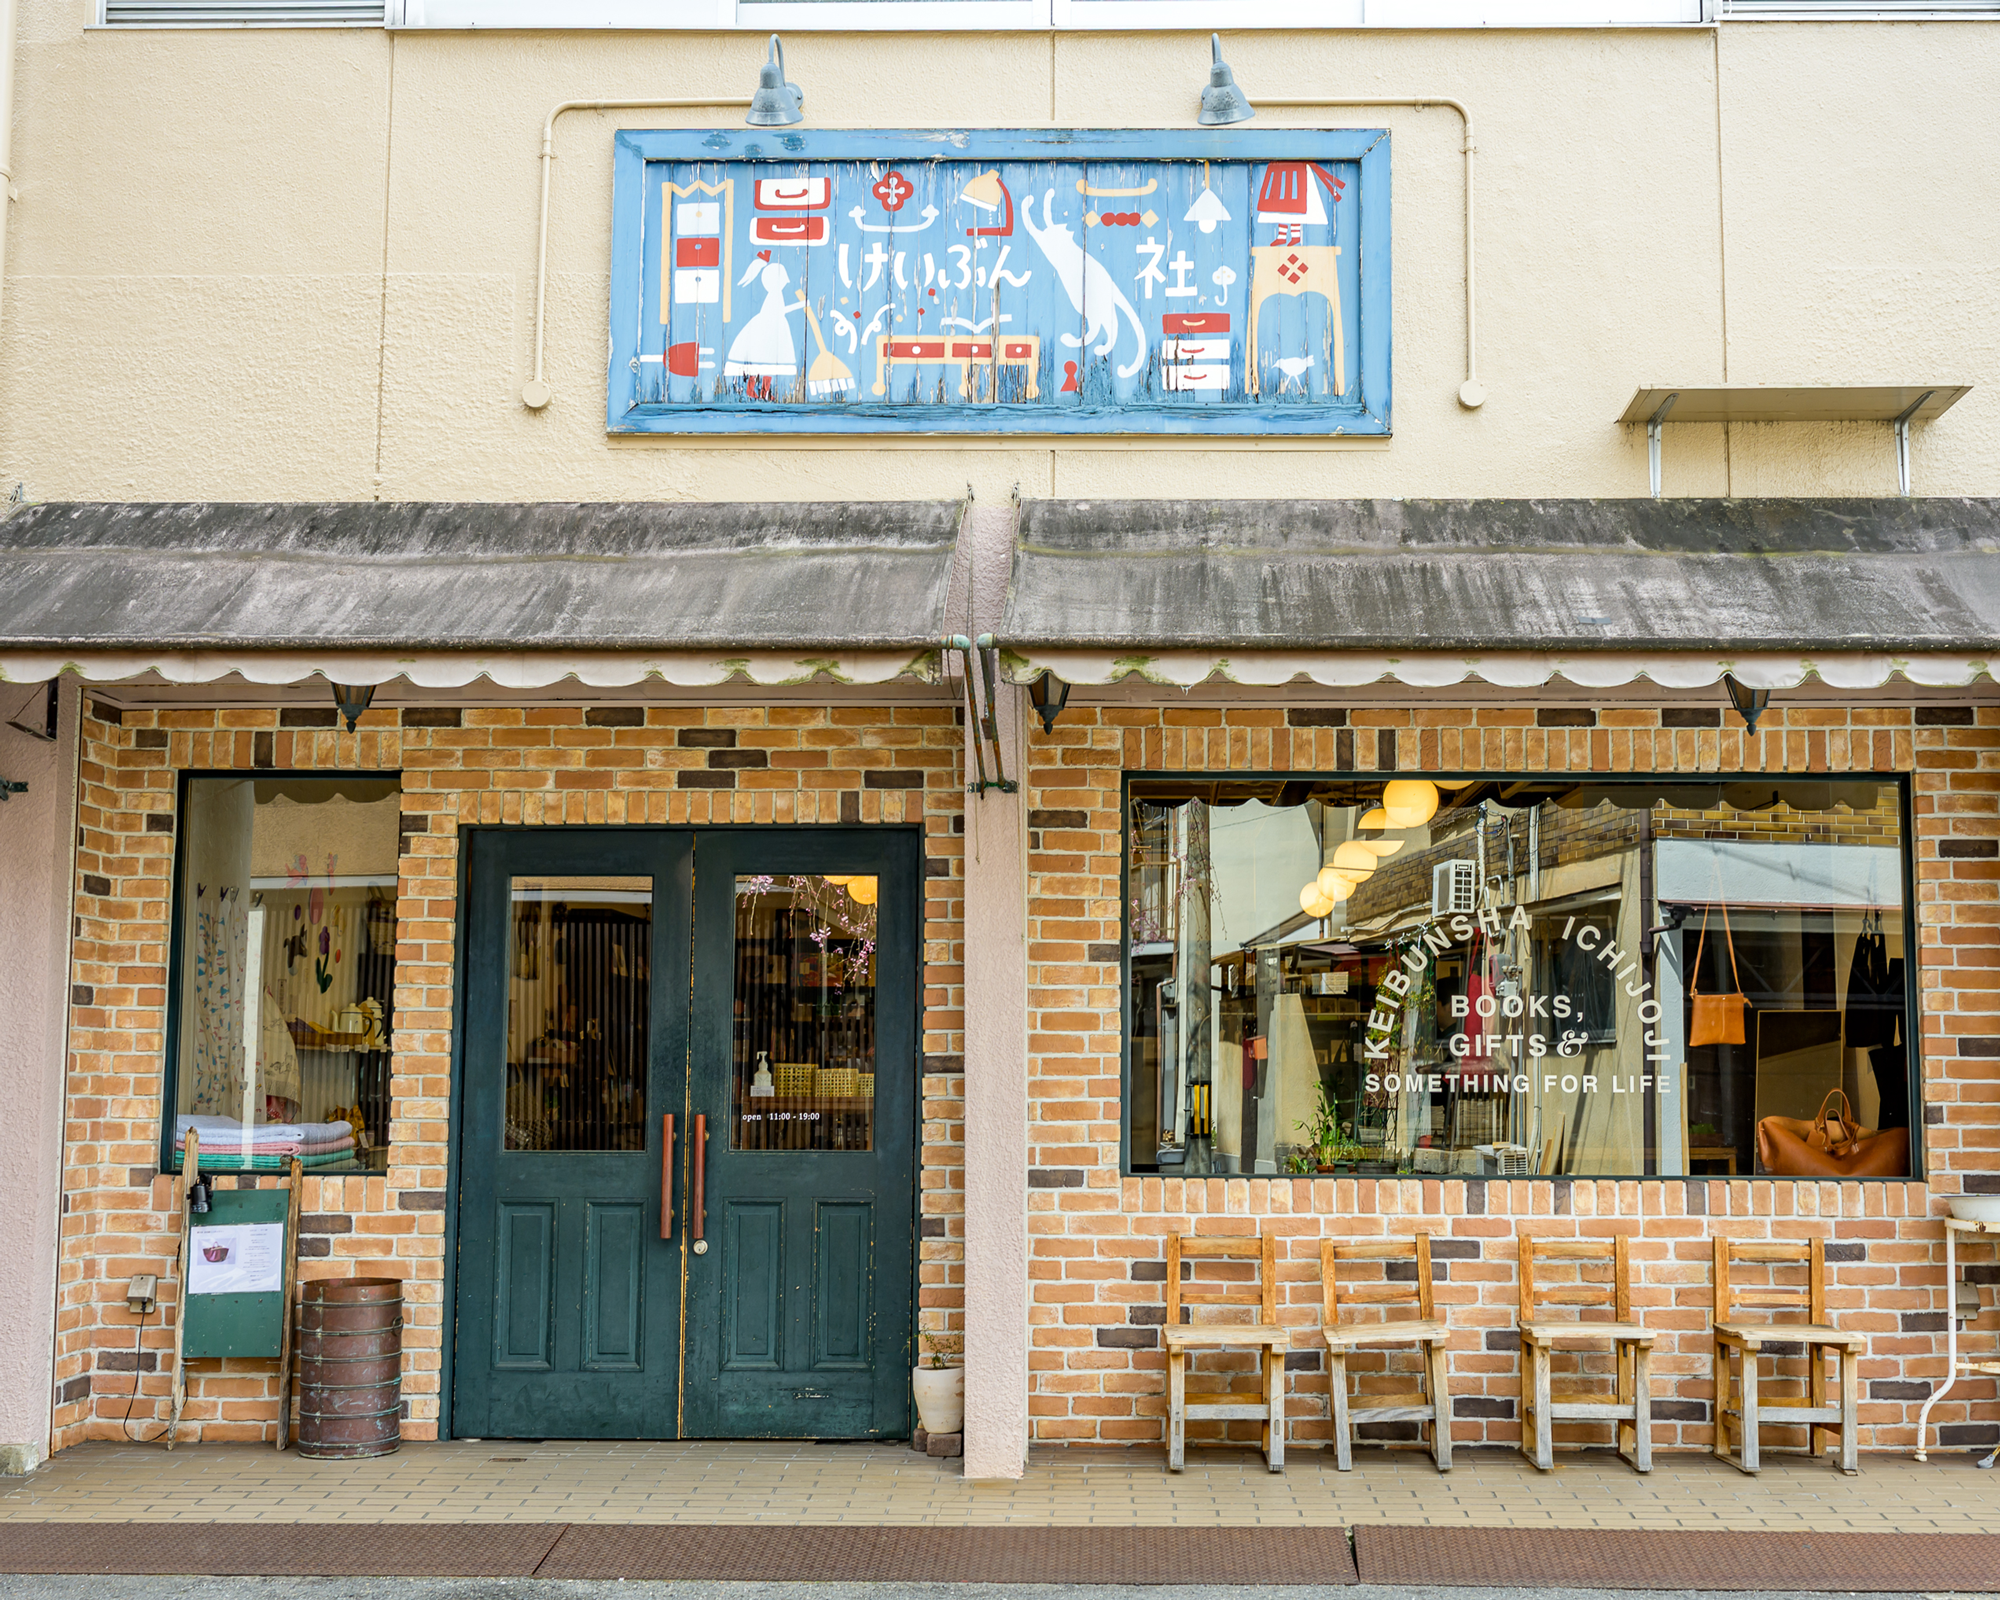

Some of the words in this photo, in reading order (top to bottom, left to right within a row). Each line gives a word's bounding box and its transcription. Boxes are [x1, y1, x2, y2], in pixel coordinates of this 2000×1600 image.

[838, 237, 1032, 292] けいぶん
[1133, 236, 1198, 299] 社
[1364, 905, 1533, 1060] KEIBUNSHA
[1561, 915, 1671, 1061] ICHIJOJI
[1451, 994, 1584, 1023] BOOKS,
[1449, 1033, 1548, 1058] GIFTS
[1556, 1029, 1589, 1058] &
[1364, 1073, 1530, 1093] SOMETHING
[1544, 1074, 1599, 1093] FOR
[1612, 1074, 1671, 1093] LIFE
[742, 1114, 762, 1123] open
[769, 1112, 791, 1121] 11:00
[798, 1112, 820, 1121] 19:00
